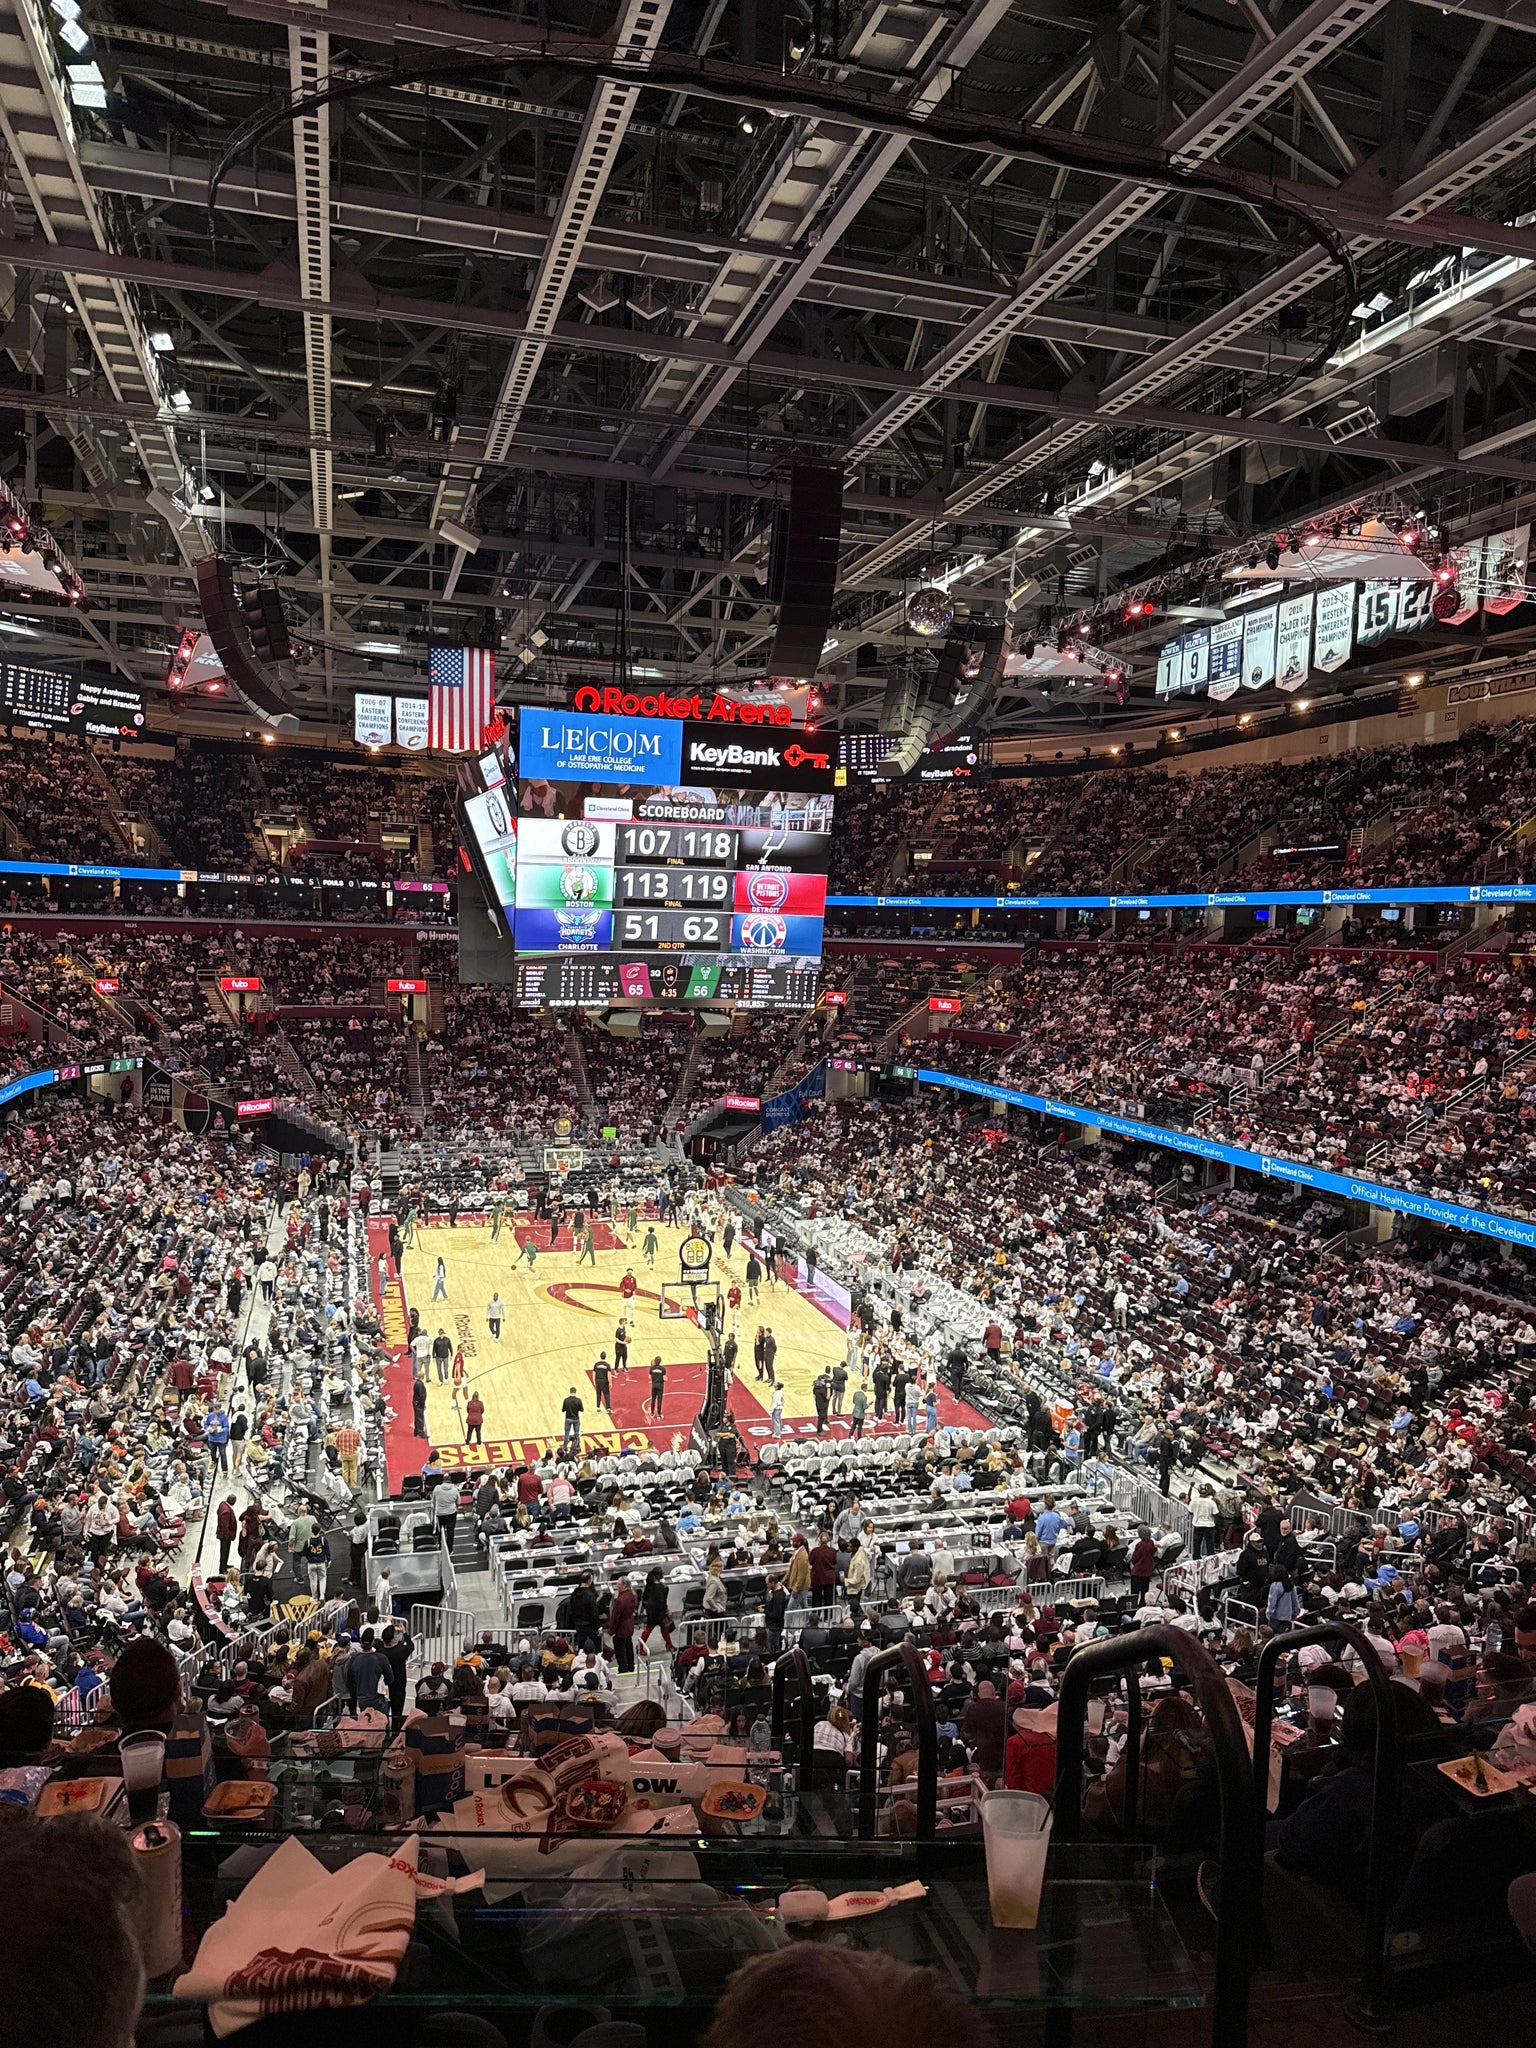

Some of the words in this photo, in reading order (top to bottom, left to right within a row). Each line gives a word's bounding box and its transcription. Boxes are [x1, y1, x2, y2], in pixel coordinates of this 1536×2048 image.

[1289, 604, 1303, 616] 2016
[1322, 607, 1347, 621] WESTERN
[1364, 592, 1390, 630] 15
[1212, 619, 1242, 635] CLEVELAND
[1246, 620, 1274, 636] CHAMPIONS
[1317, 617, 1350, 634] CONFERENCE
[1216, 629, 1237, 641] BARONS
[1280, 627, 1309, 645] CHAMPIONS
[1318, 629, 1348, 645] CHAMPIONS
[1184, 636, 1208, 649] GLOVER
[1190, 651, 1199, 680] 9
[1166, 659, 1171, 687] 1
[80, 683, 102, 694] Happy
[102, 687, 141, 701] Anniversary
[77, 694, 98, 705] Gabby
[99, 697, 112, 706] and
[112, 699, 142, 710] Brandon!
[360, 698, 387, 706] 2006-07
[401, 702, 426, 710] 2014-15
[603, 687, 703, 719] Rocket
[707, 694, 792, 726] Arena
[362, 707, 385, 715] EASTERN
[357, 714, 390, 723] CONFERENCE
[86, 722, 120, 735] KeyBank
[358, 721, 389, 730] CHAMPIONS
[569, 754, 587, 762] LAKE
[587, 755, 602, 763] ERIE
[602, 756, 632, 764] COLLEGE
[690, 743, 781, 766] KeyBank
[568, 761, 613, 771] OSTEOPATHIC
[613, 764, 646, 773] MEDICINE
[921, 769, 953, 778] KeyBank
[638, 804, 725, 821] SCOREBOARD
[624, 829, 672, 855] 107
[684, 831, 731, 858] 118
[78, 867, 105, 876] Cleveland
[105, 868, 121, 876] Clinic
[745, 864, 761, 872] SAN
[761, 865, 792, 873] ANTONIO
[422, 883, 433, 891] 65
[622, 872, 669, 898] 113
[681, 874, 728, 900] 119
[1215, 895, 1234, 903] Cleveland
[1234, 894, 1246, 902] Clinic
[1332, 892, 1356, 901] Cleveland
[1356, 892, 1371, 900] Clinic
[1481, 889, 1512, 899] Cleveland
[1512, 887, 1532, 897] Clinic
[1117, 898, 1137, 906] Cleveland
[560, 927, 593, 936] HORNETS
[625, 915, 659, 940] 51
[683, 917, 719, 941] 62
[740, 947, 786, 955] WASHINGTON
[231, 979, 249, 988] fubo
[398, 981, 416, 990] fubo
[628, 984, 644, 995] 65
[661, 988, 677, 998] 4:35
[693, 985, 708, 997] 56
[938, 1000, 952, 1009] fubo
[84, 1064, 105, 1074] BLOCKS
[150, 1094, 171, 1102] PAINT
[157, 1088, 171, 1096] THE
[808, 1089, 823, 1097] Court
[246, 1102, 271, 1112] Rocket
[734, 1098, 759, 1108] Rocket
[1096, 1116, 1113, 1128] Official
[1113, 1120, 1137, 1134] Healthcare
[1137, 1127, 1157, 1140] Provider
[1157, 1132, 1163, 1141] of
[1163, 1134, 1173, 1144] the
[1173, 1136, 1199, 1151] Cleveland
[1199, 1143, 1225, 1158] Cavaliers
[1270, 1162, 1297, 1176] Cleveland
[1297, 1168, 1314, 1181] Clinic
[1351, 1183, 1379, 1200] Official
[1379, 1193, 1422, 1212] Healthcare
[1423, 1202, 1458, 1221] Provider
[1459, 1214, 1469, 1224] of
[1471, 1216, 1486, 1229] the
[1488, 1219, 1535, 1243] Cleveland
[632, 1778, 682, 1794] OW.
[474, 1803, 486, 1828] Rocket
[845, 1897, 878, 1907] Rocket
